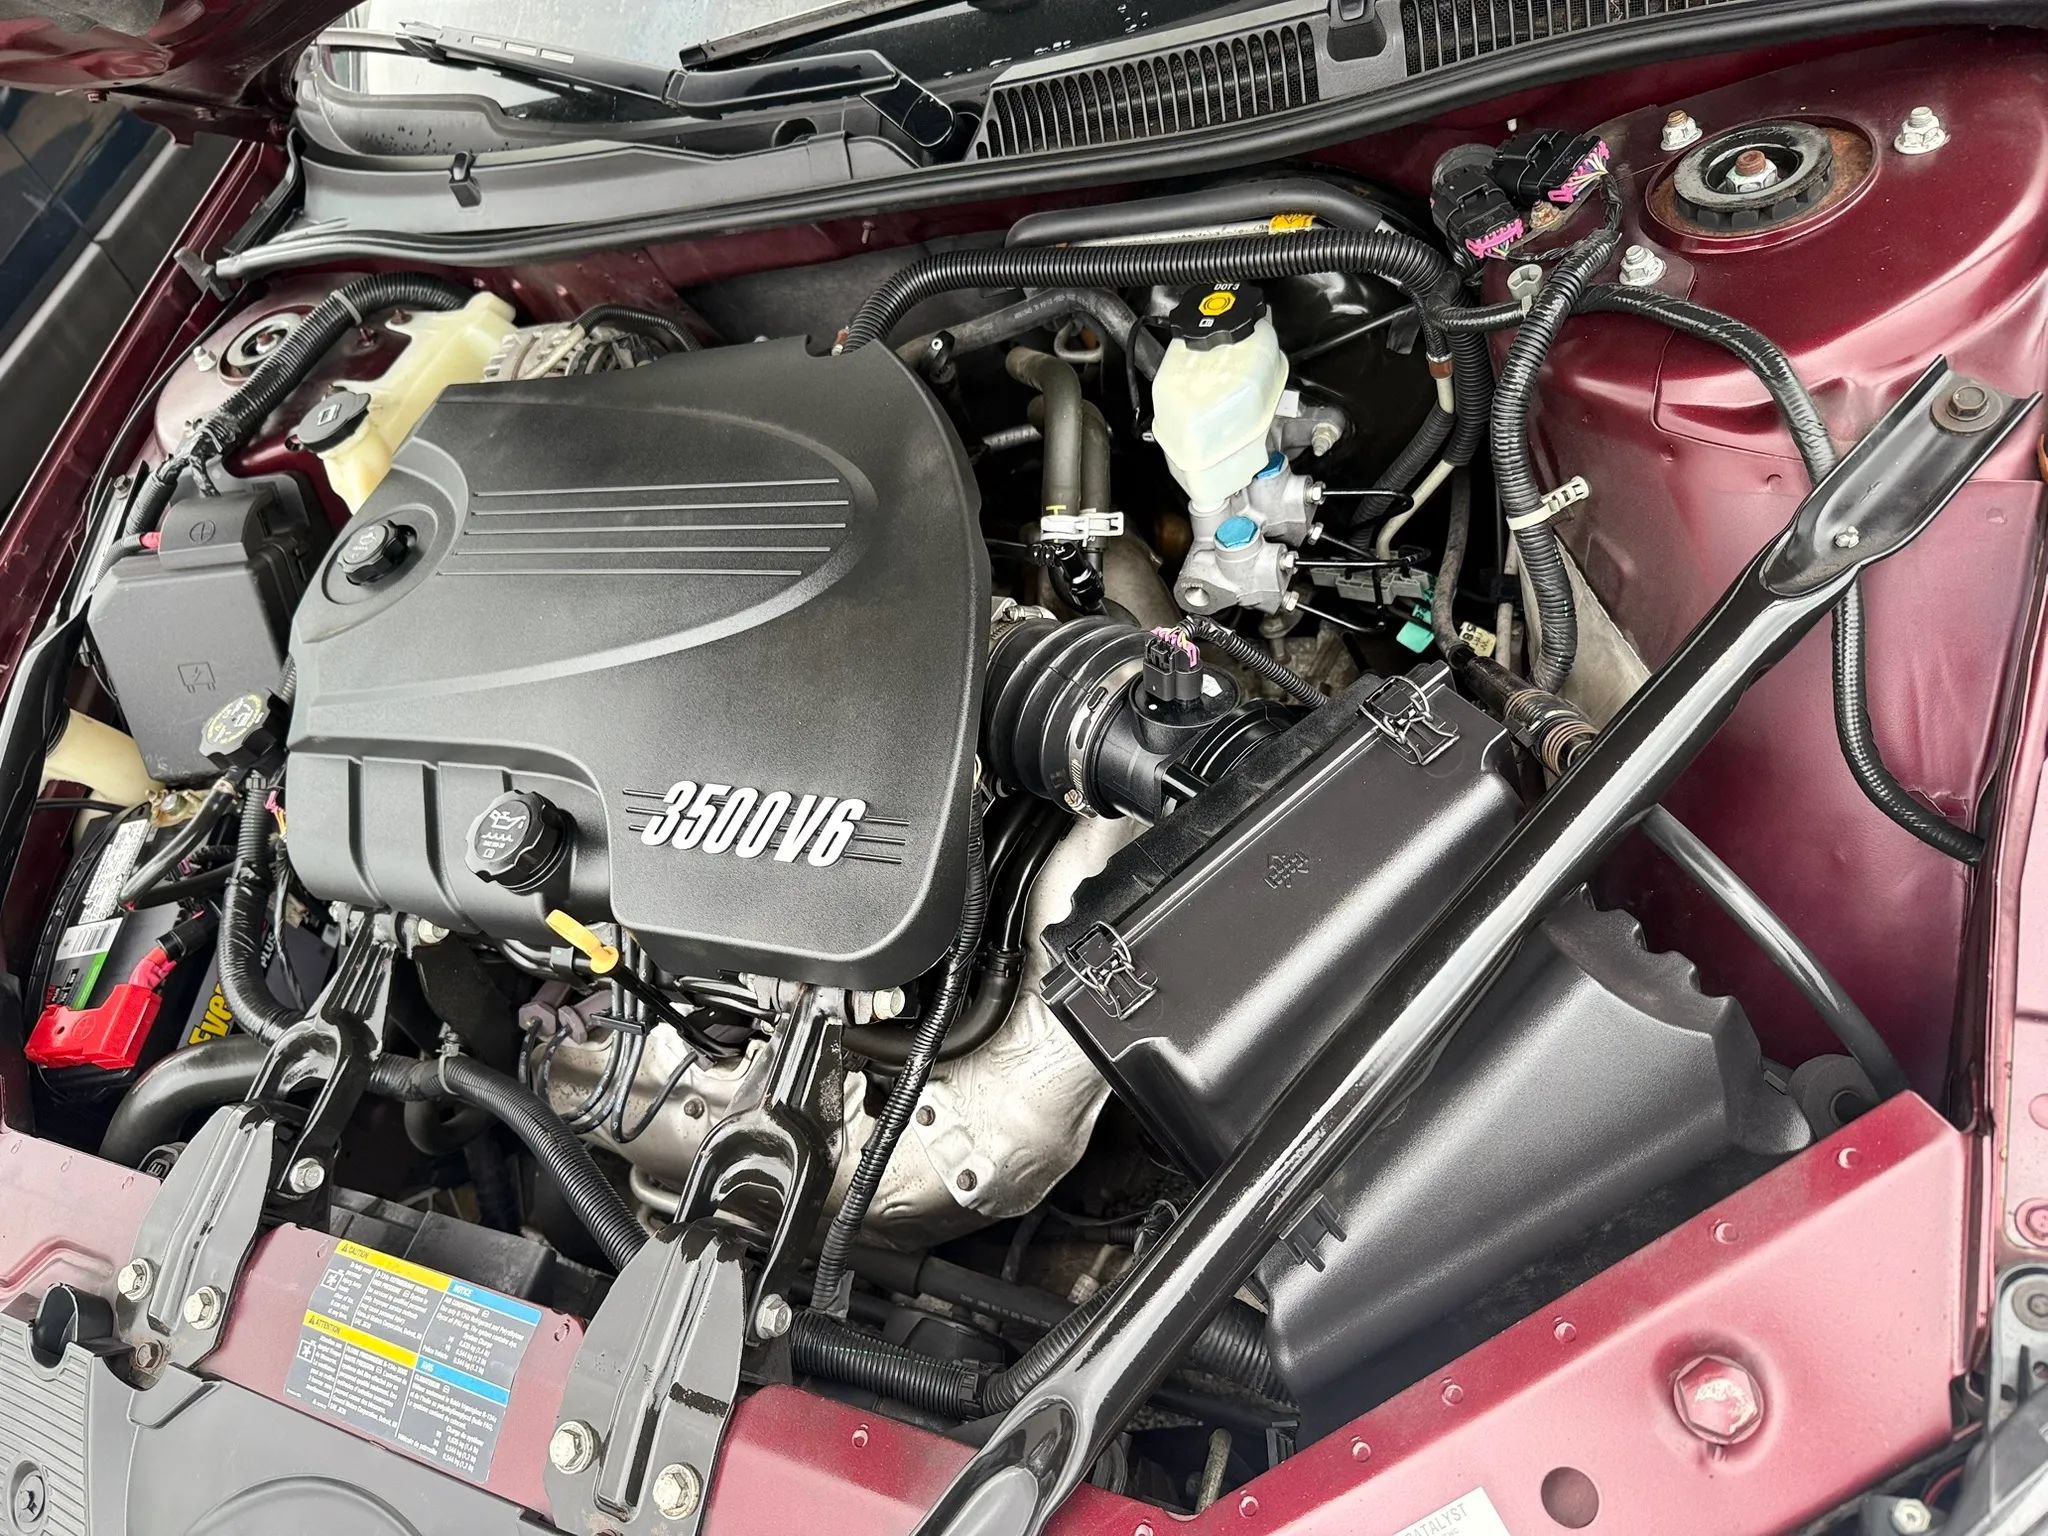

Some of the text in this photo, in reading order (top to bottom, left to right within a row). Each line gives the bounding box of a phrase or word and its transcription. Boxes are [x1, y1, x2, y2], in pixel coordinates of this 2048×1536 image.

[1214, 283, 1233, 291] DOT
[187, 982, 236, 1045] Eve
[1404, 1503, 1467, 1536] ATALYST
